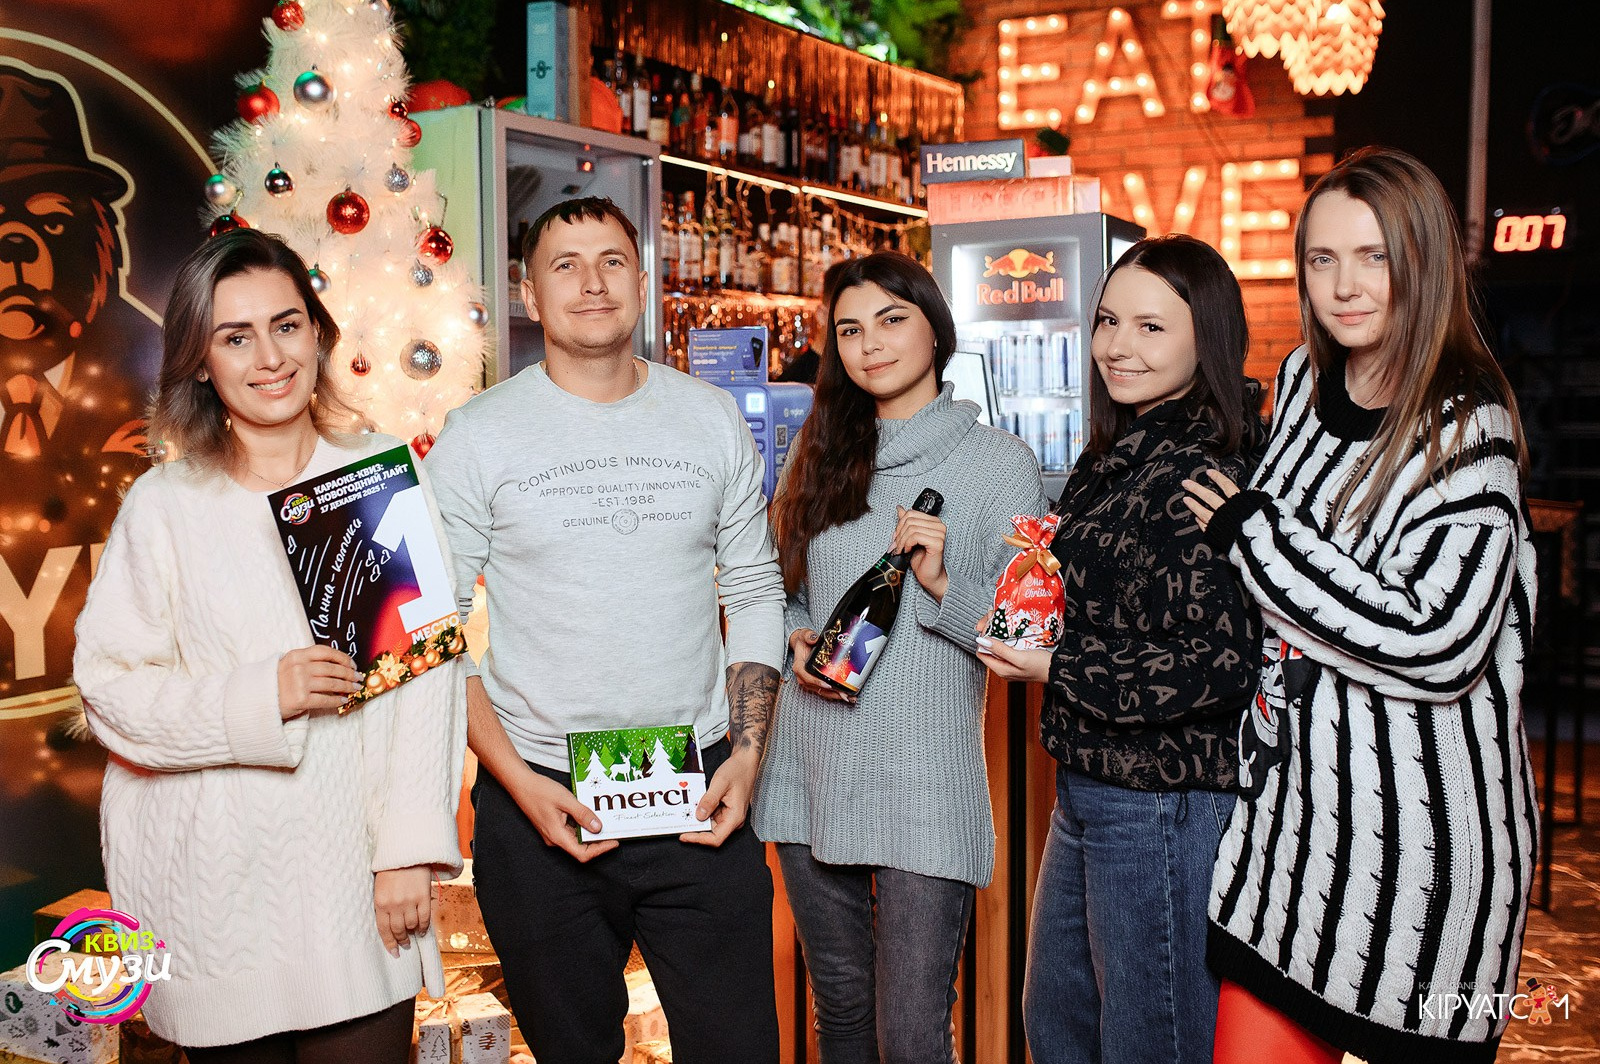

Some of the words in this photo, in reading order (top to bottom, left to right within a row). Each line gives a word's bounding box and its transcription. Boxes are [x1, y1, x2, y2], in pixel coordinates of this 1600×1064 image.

[998, 0, 1222, 130] EAT
[926, 151, 1017, 173] Hennessy
[1493, 214, 1566, 252] 007
[976, 280, 1019, 306] Red
[1021, 277, 1064, 303] Bull
[313, 463, 385, 495] КАРАОКЕ-КВИЗ:
[316, 471, 382, 504] НОВОГОДНИЙ
[382, 463, 409, 480] ЛАЙТ
[518, 456, 618, 492] CONTINUOUS
[319, 505, 330, 514] 17
[329, 494, 363, 512] ДЕКАБРЯ
[363, 486, 381, 498] 2025
[539, 485, 594, 498] APPROVED
[597, 480, 701, 493] QUALITY/INNOVATIVE
[280, 498, 315, 522] Смузи
[562, 516, 610, 528] GENUINE
[641, 511, 693, 522] PRODUCT
[371, 484, 458, 634] 1
[411, 614, 460, 645] МЕСТО
[593, 783, 690, 811] merci
[643, 811, 677, 820] Selection
